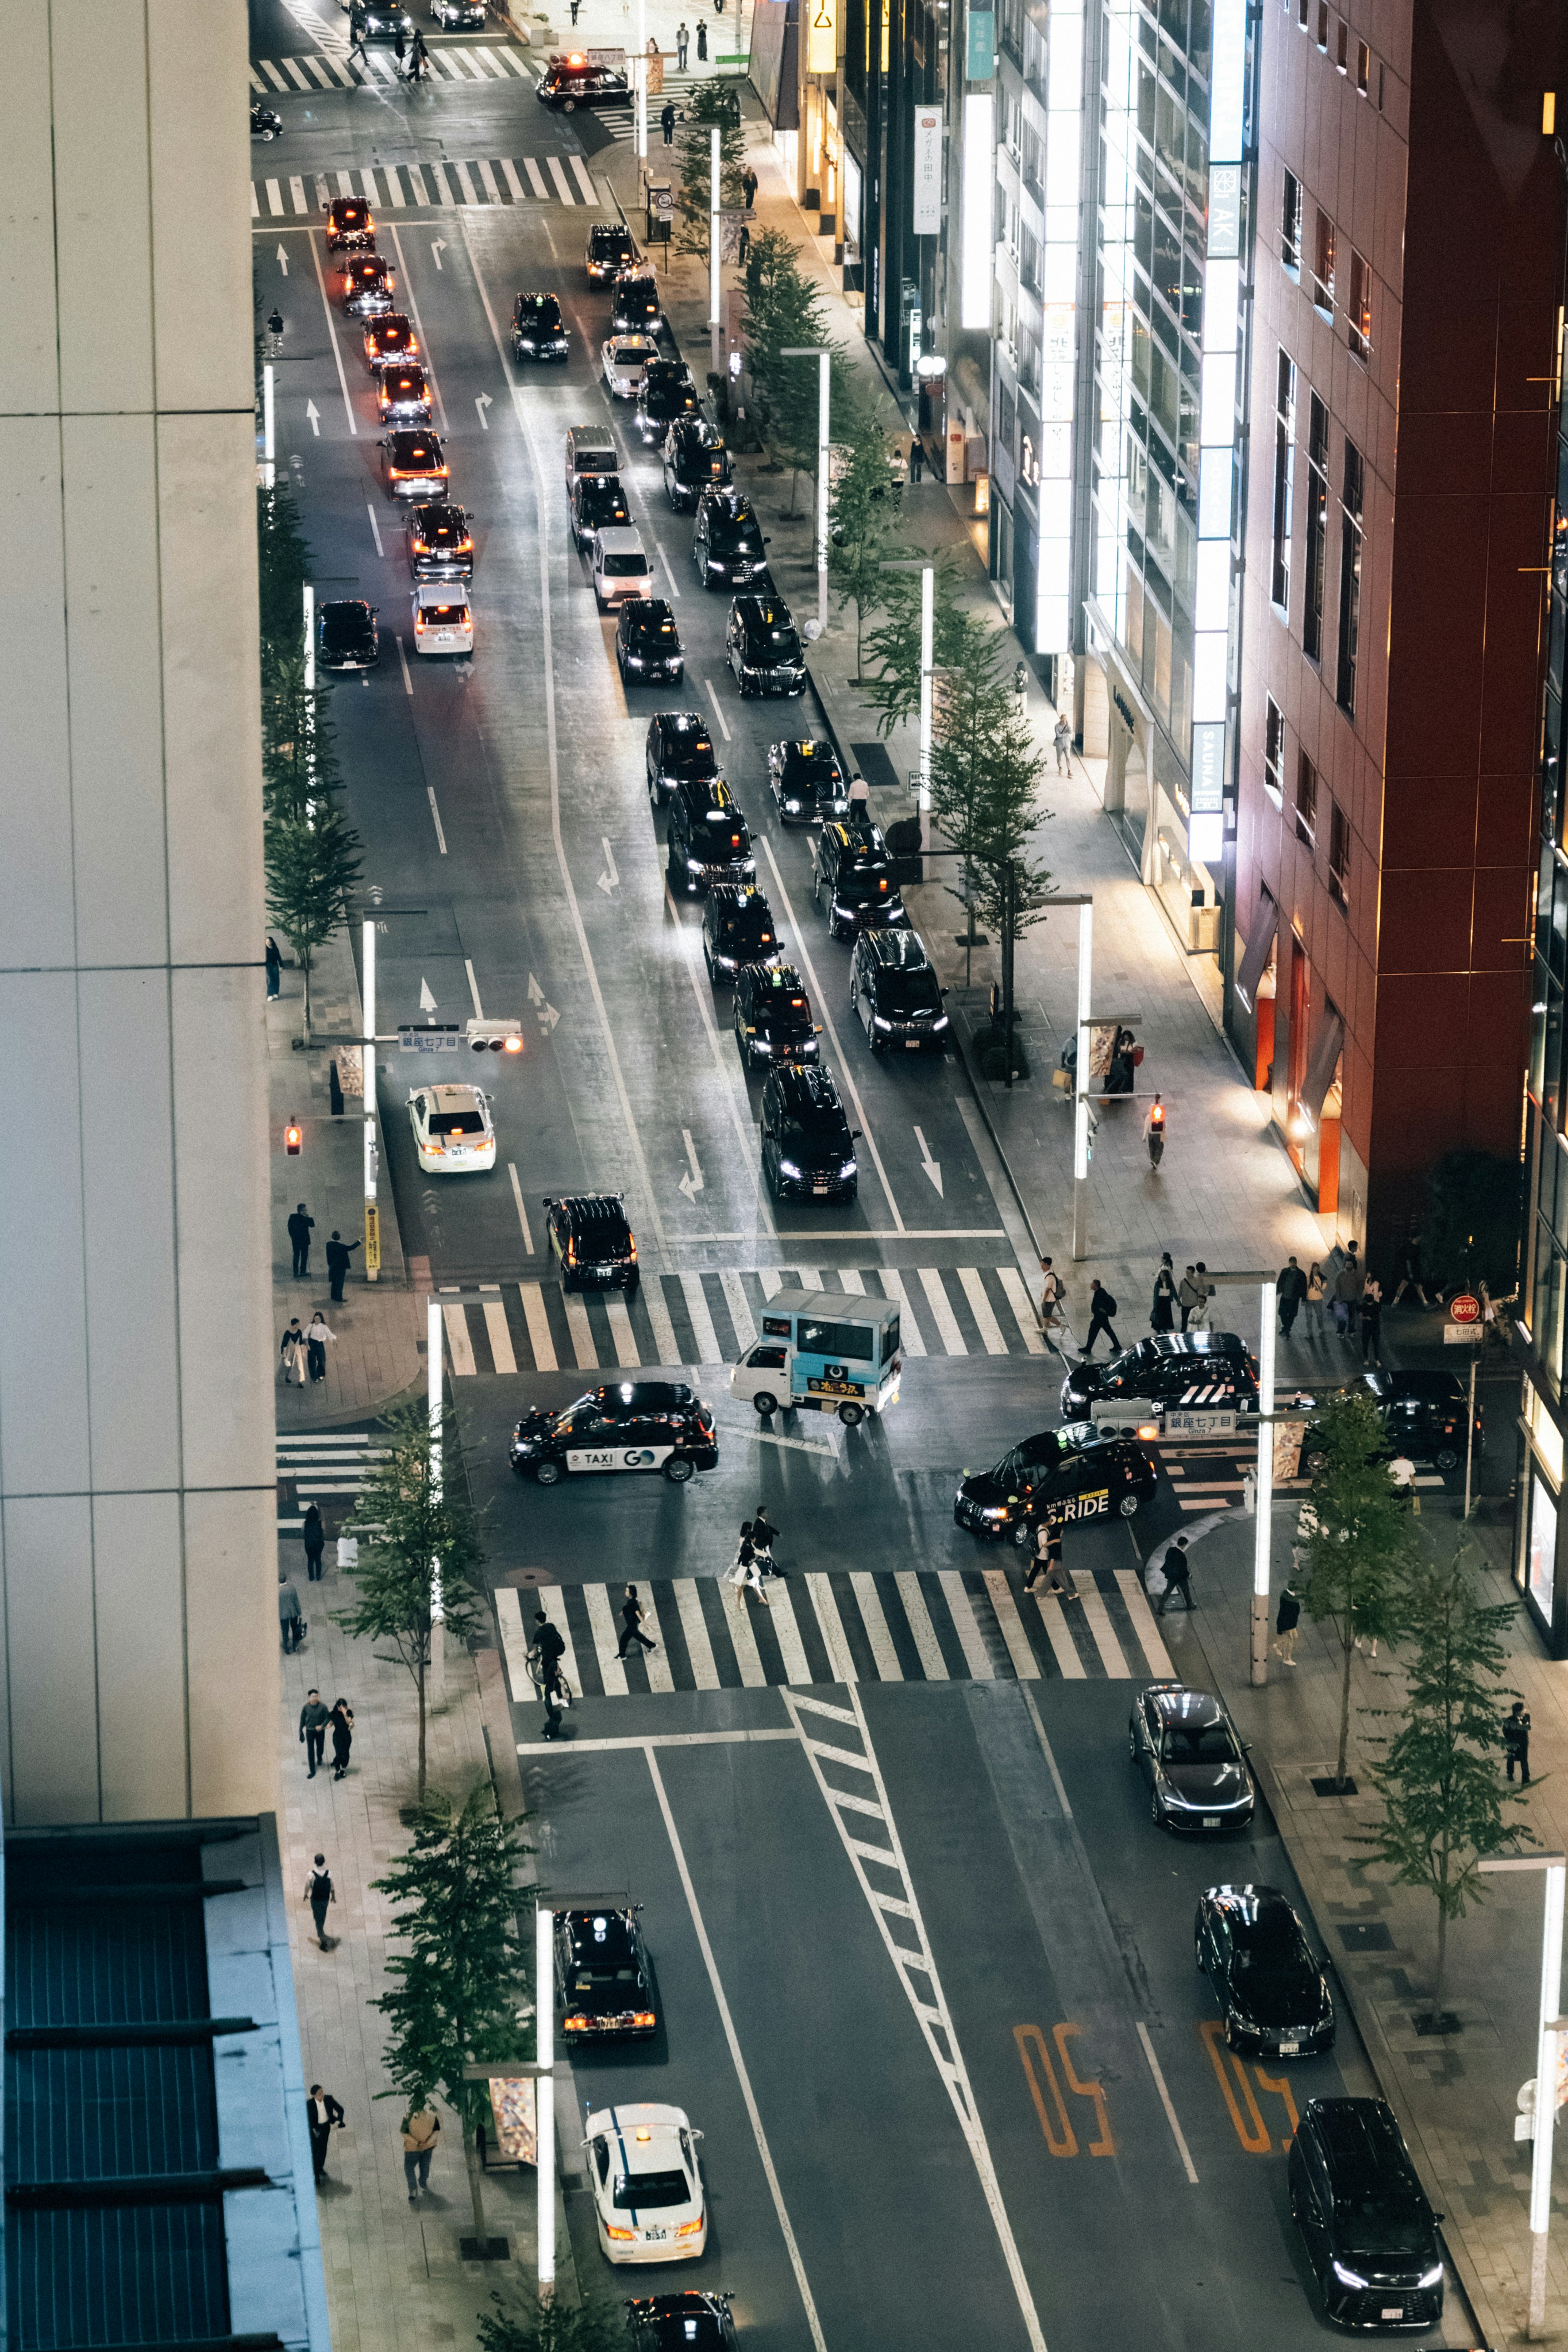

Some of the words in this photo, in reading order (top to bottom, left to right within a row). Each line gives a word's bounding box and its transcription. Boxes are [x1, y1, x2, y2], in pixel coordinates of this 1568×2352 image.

[924, 130, 933, 182] メガネの田中
[1213, 208, 1234, 236] AK
[1202, 731, 1215, 787] SAUNA
[403, 1037, 456, 1046] 銀座七丁目
[1454, 1303, 1476, 1315] 消火栓
[1456, 1327, 1477, 1335] 七田式
[1151, 1402, 1167, 1412] er
[1171, 1416, 1230, 1428] 銀座七丁目
[585, 1454, 612, 1464] TAXI
[624, 1450, 655, 1466] GO
[1047, 1495, 1109, 1526] S.RIDE
[1013, 2023, 1116, 2157] 50
